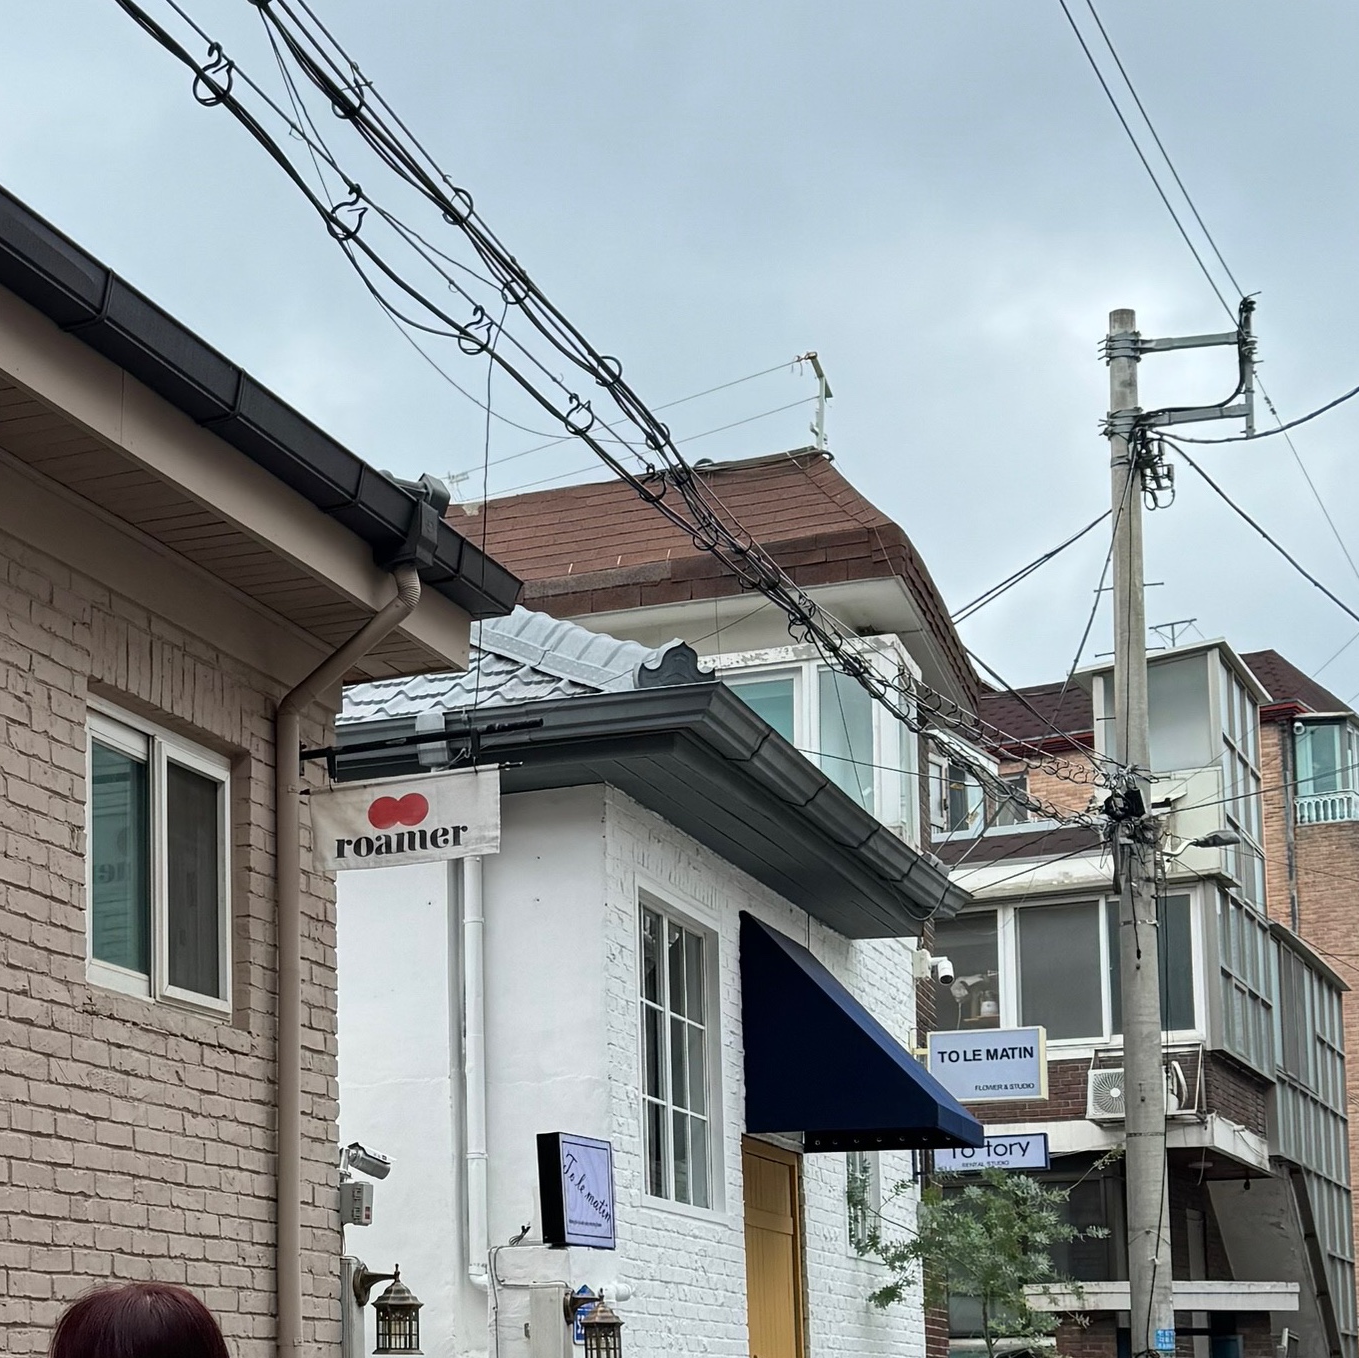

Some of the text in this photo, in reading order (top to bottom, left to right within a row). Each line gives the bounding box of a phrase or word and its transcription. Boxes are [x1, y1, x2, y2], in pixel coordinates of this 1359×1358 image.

[335, 825, 468, 859] roamer
[937, 1046, 1034, 1063] TO LE MATIN
